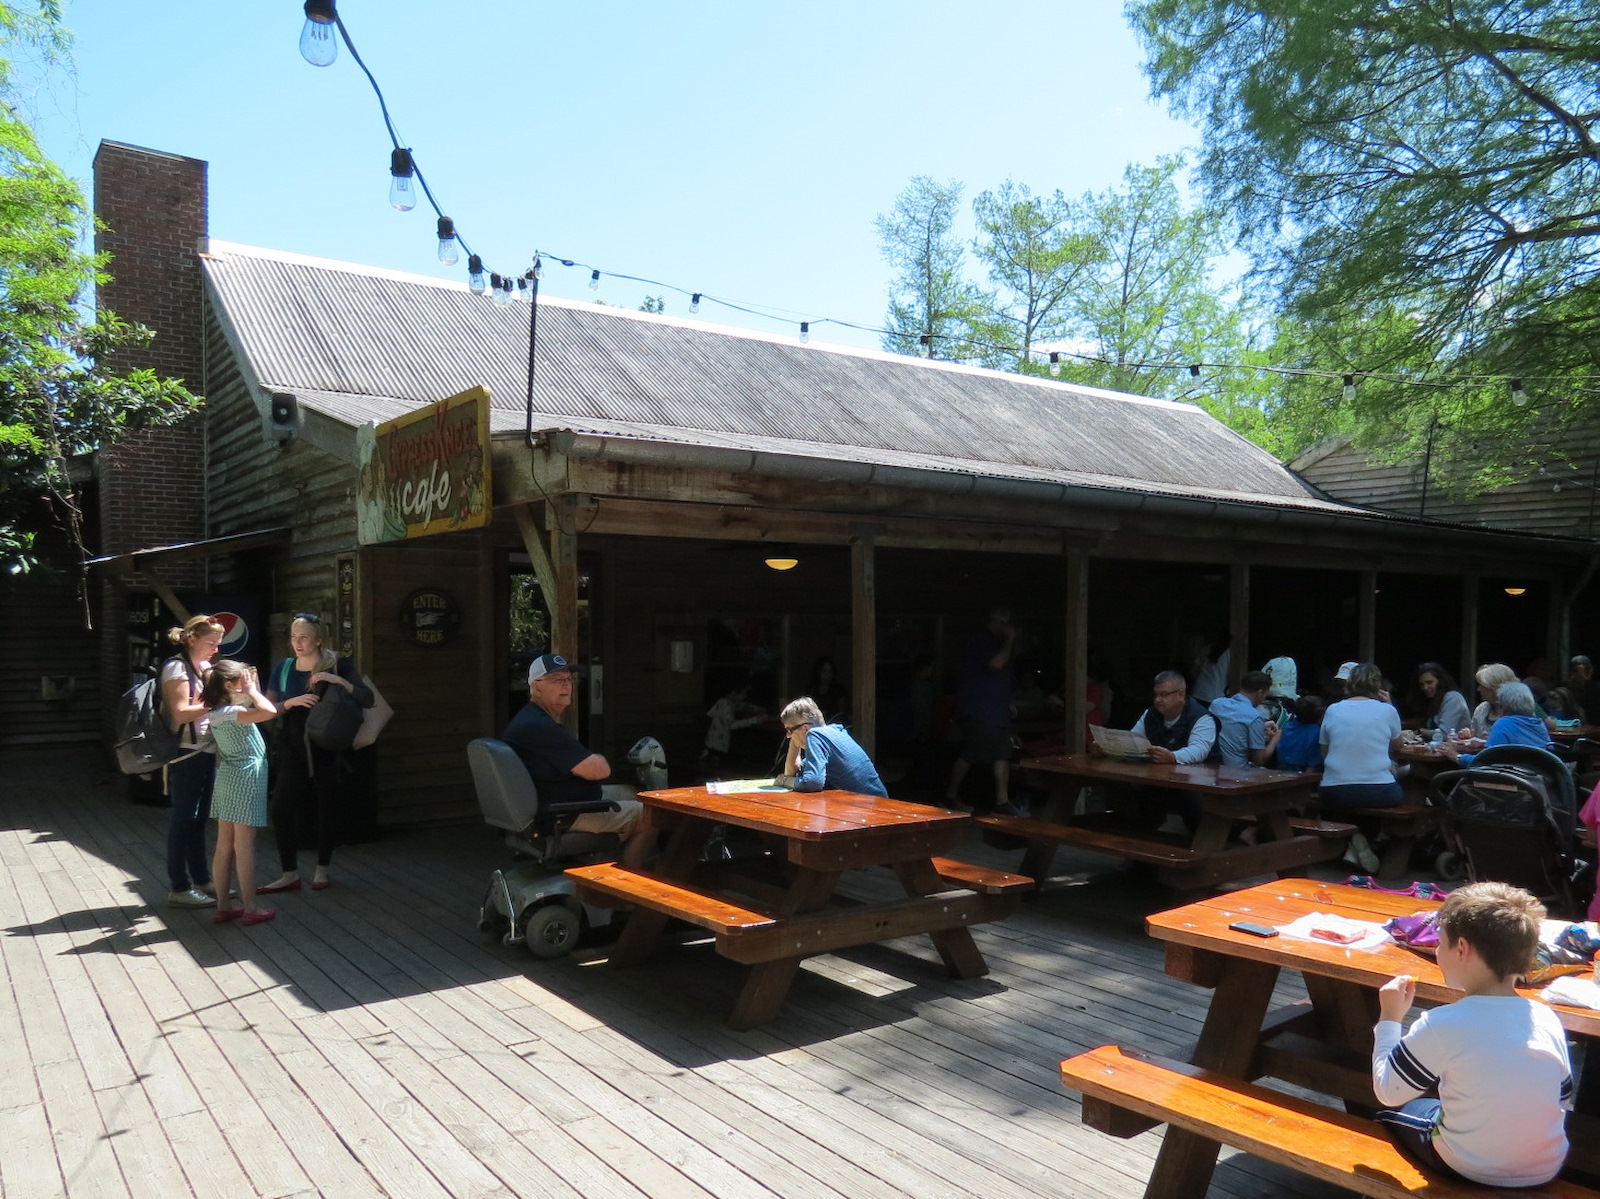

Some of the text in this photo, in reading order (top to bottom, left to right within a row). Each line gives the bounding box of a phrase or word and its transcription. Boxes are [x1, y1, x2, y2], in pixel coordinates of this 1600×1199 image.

[401, 459, 452, 531] cafe
[412, 593, 447, 609] ENTER
[416, 629, 445, 644] HERE
